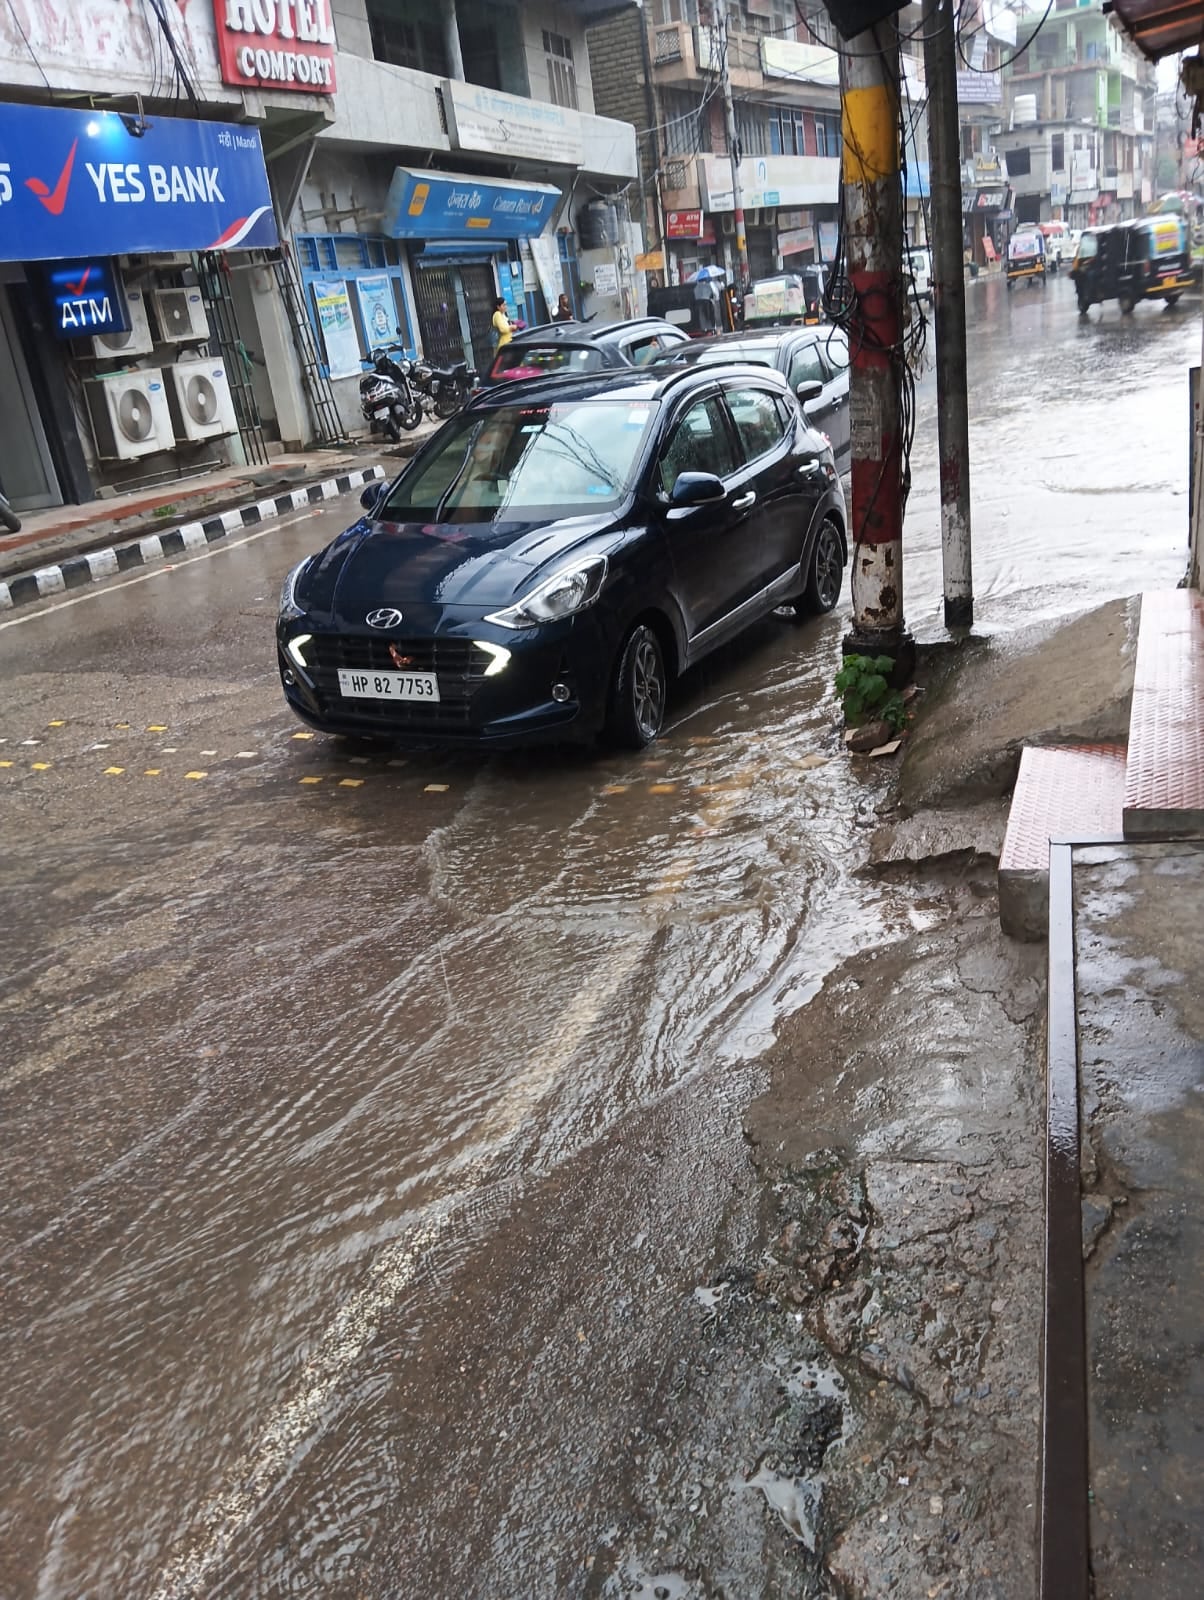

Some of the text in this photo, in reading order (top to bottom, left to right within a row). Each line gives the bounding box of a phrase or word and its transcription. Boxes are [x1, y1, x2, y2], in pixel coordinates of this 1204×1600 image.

[225, 0, 335, 44] HOTEL
[239, 46, 333, 85] COMFORT
[236, 135, 257, 149] Mandi
[85, 163, 225, 203] YES BANK
[62, 297, 113, 328] ATM
[351, 675, 433, 696] HP 82 7753
